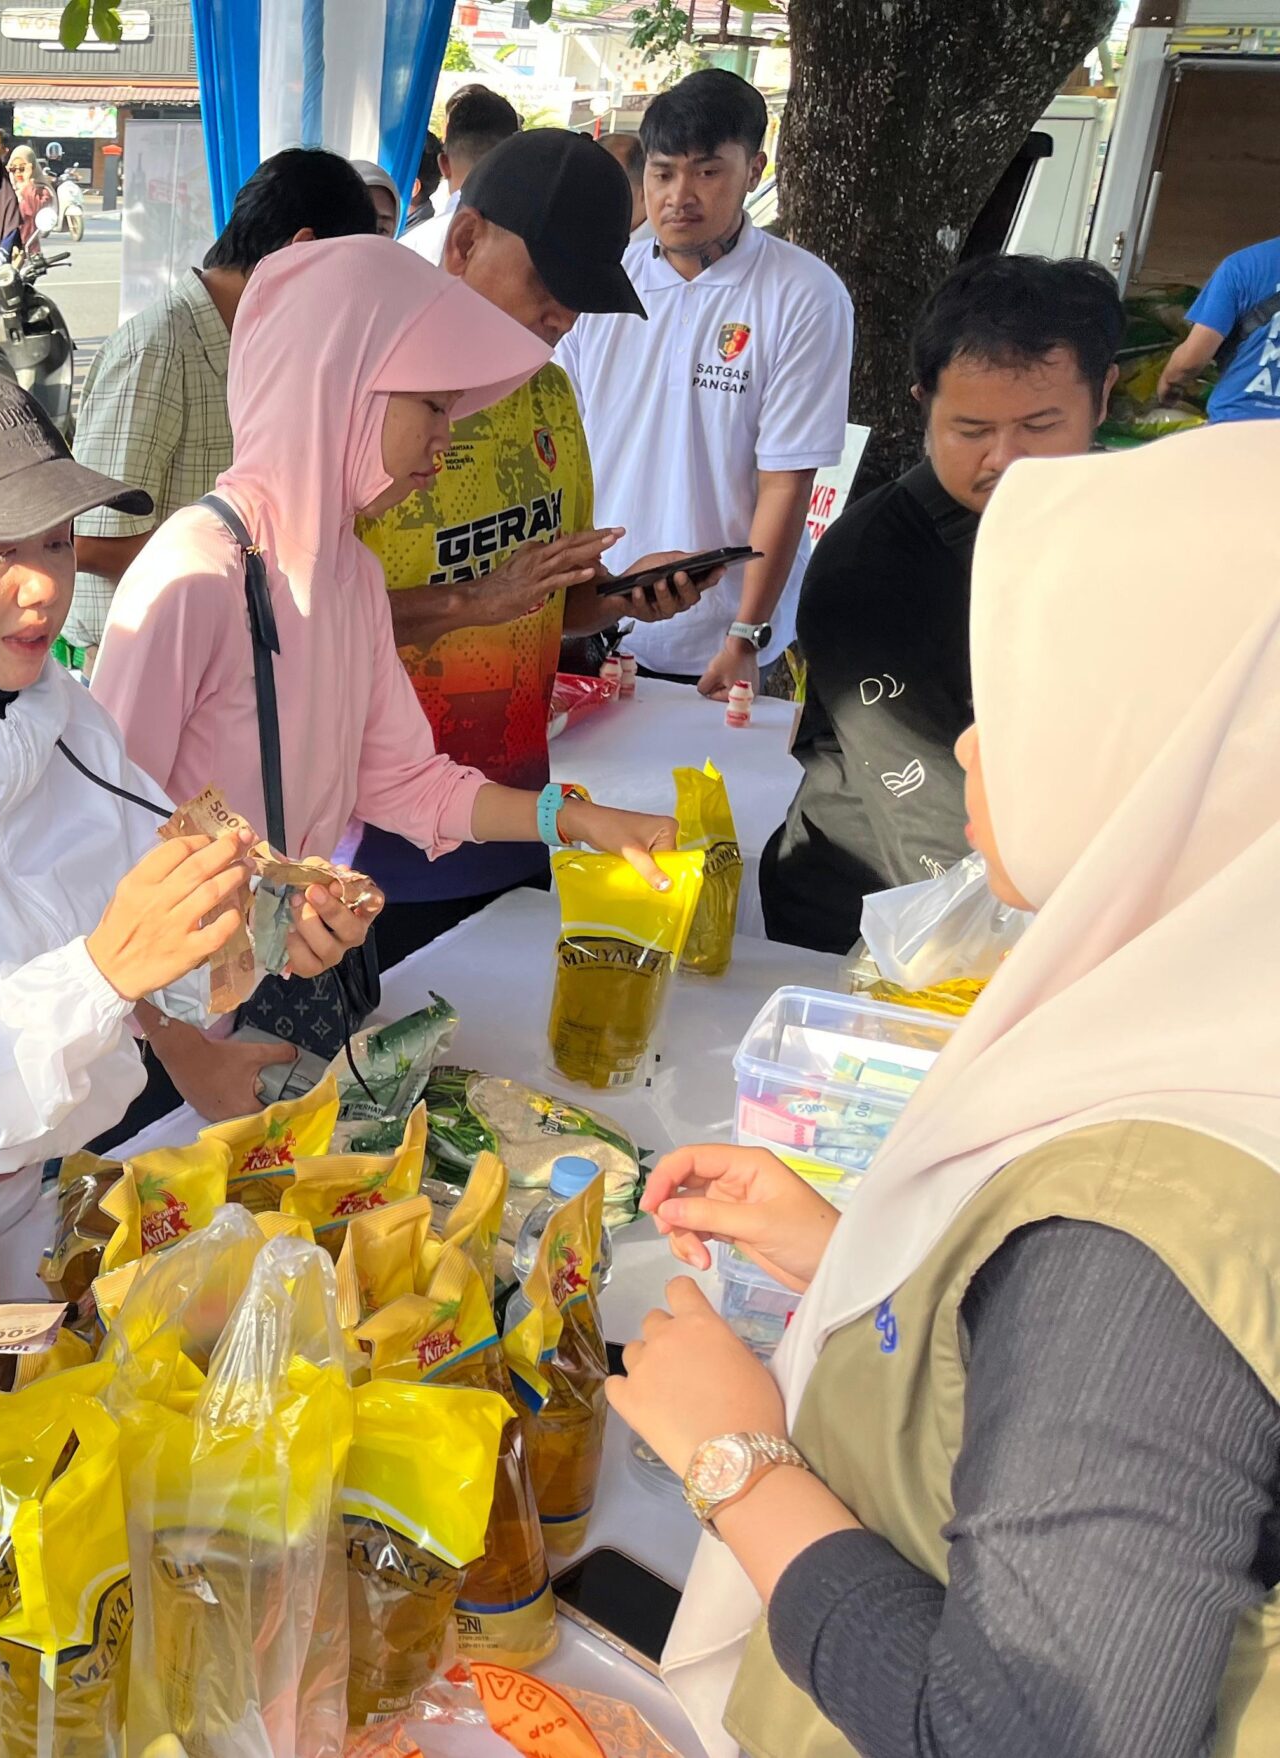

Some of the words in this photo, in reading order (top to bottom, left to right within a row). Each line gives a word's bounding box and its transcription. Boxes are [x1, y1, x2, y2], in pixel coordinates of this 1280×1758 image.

[695, 363, 750, 380] SATGAS
[692, 377, 748, 394] PANGAN
[436, 488, 563, 567] GERAK
[456, 1615, 482, 1634] SNI
